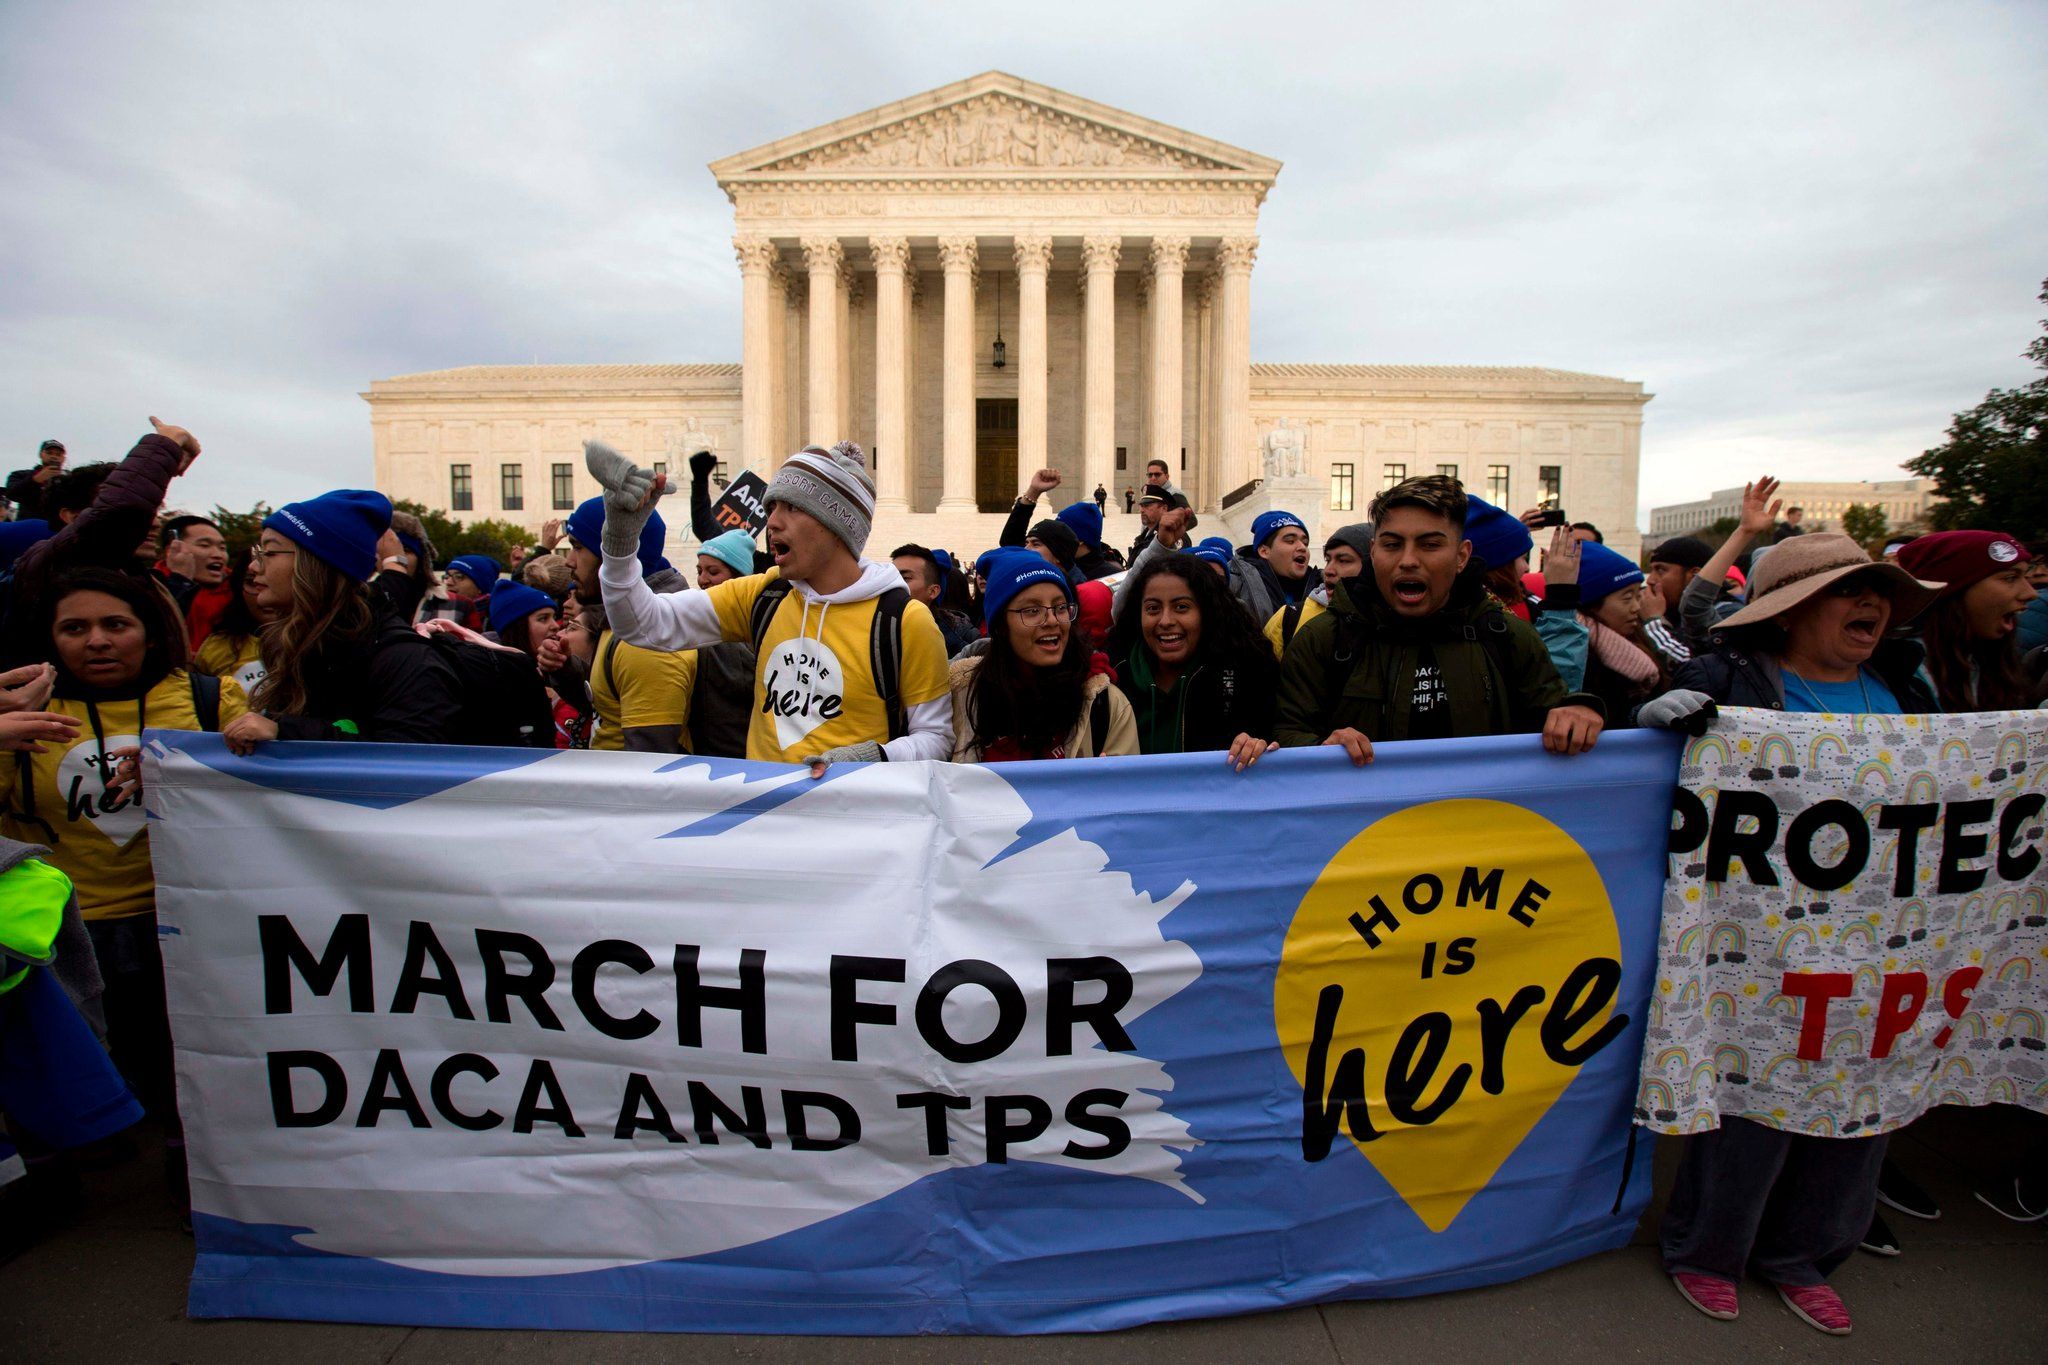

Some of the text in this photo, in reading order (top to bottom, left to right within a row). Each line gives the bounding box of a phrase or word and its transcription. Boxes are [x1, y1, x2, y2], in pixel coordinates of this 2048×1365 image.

[762, 670, 844, 719] here
[783, 653, 829, 680] HOME
[796, 671, 809, 685] IS
[1665, 786, 2047, 898] PROTEC
[1347, 866, 1551, 950] HOME
[258, 913, 1137, 1064] MARCH FOR
[1420, 937, 1477, 979] IS
[1301, 957, 1630, 1162] here
[267, 1048, 1132, 1165] DACA AND TPS
